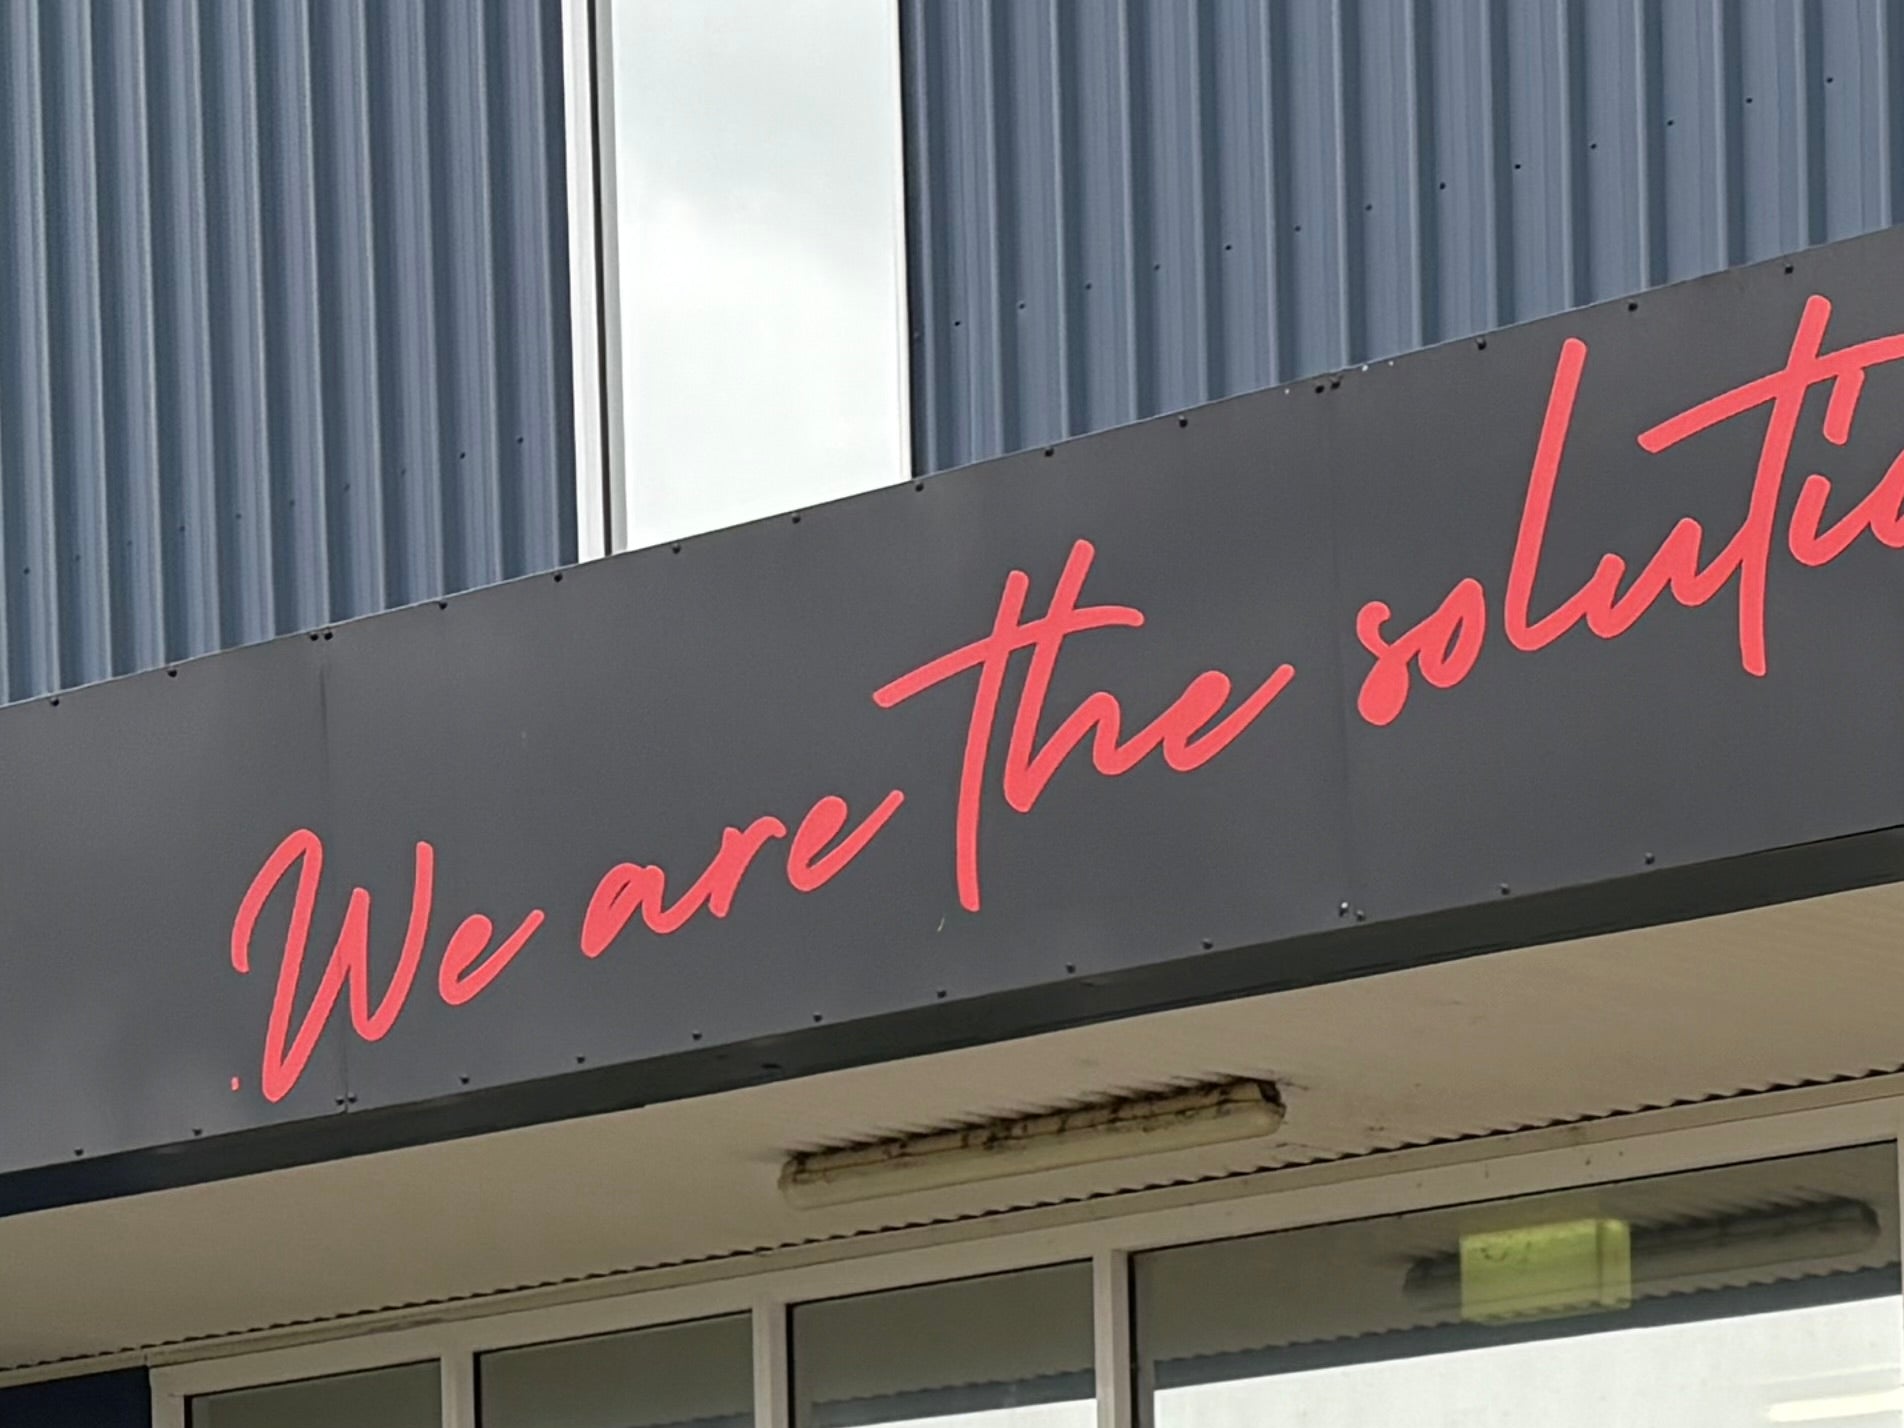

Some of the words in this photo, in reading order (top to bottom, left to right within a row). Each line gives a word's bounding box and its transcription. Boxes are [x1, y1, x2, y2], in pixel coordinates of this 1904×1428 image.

[230, 828, 546, 1104] We
[579, 789, 906, 959] are
[872, 539, 1297, 913] the
